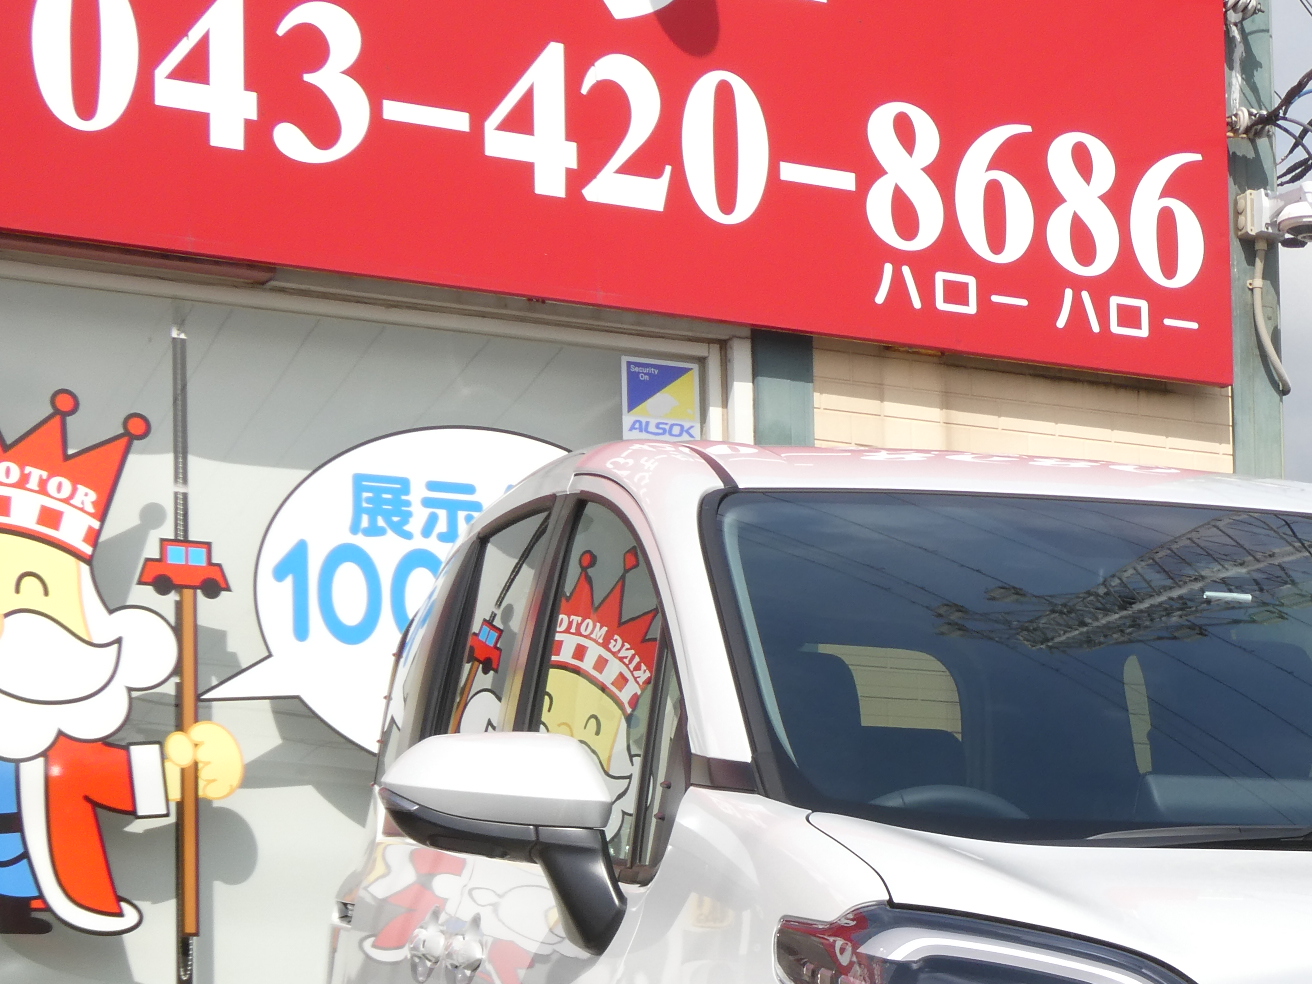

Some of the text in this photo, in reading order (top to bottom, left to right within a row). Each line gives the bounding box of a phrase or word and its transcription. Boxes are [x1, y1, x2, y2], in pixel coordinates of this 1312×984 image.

[873, 262, 1200, 339] ハロー ハロー
[630, 364, 659, 375] Security
[639, 373, 650, 381] On
[628, 419, 696, 439] ALSOK
[349, 472, 517, 544] 展示
